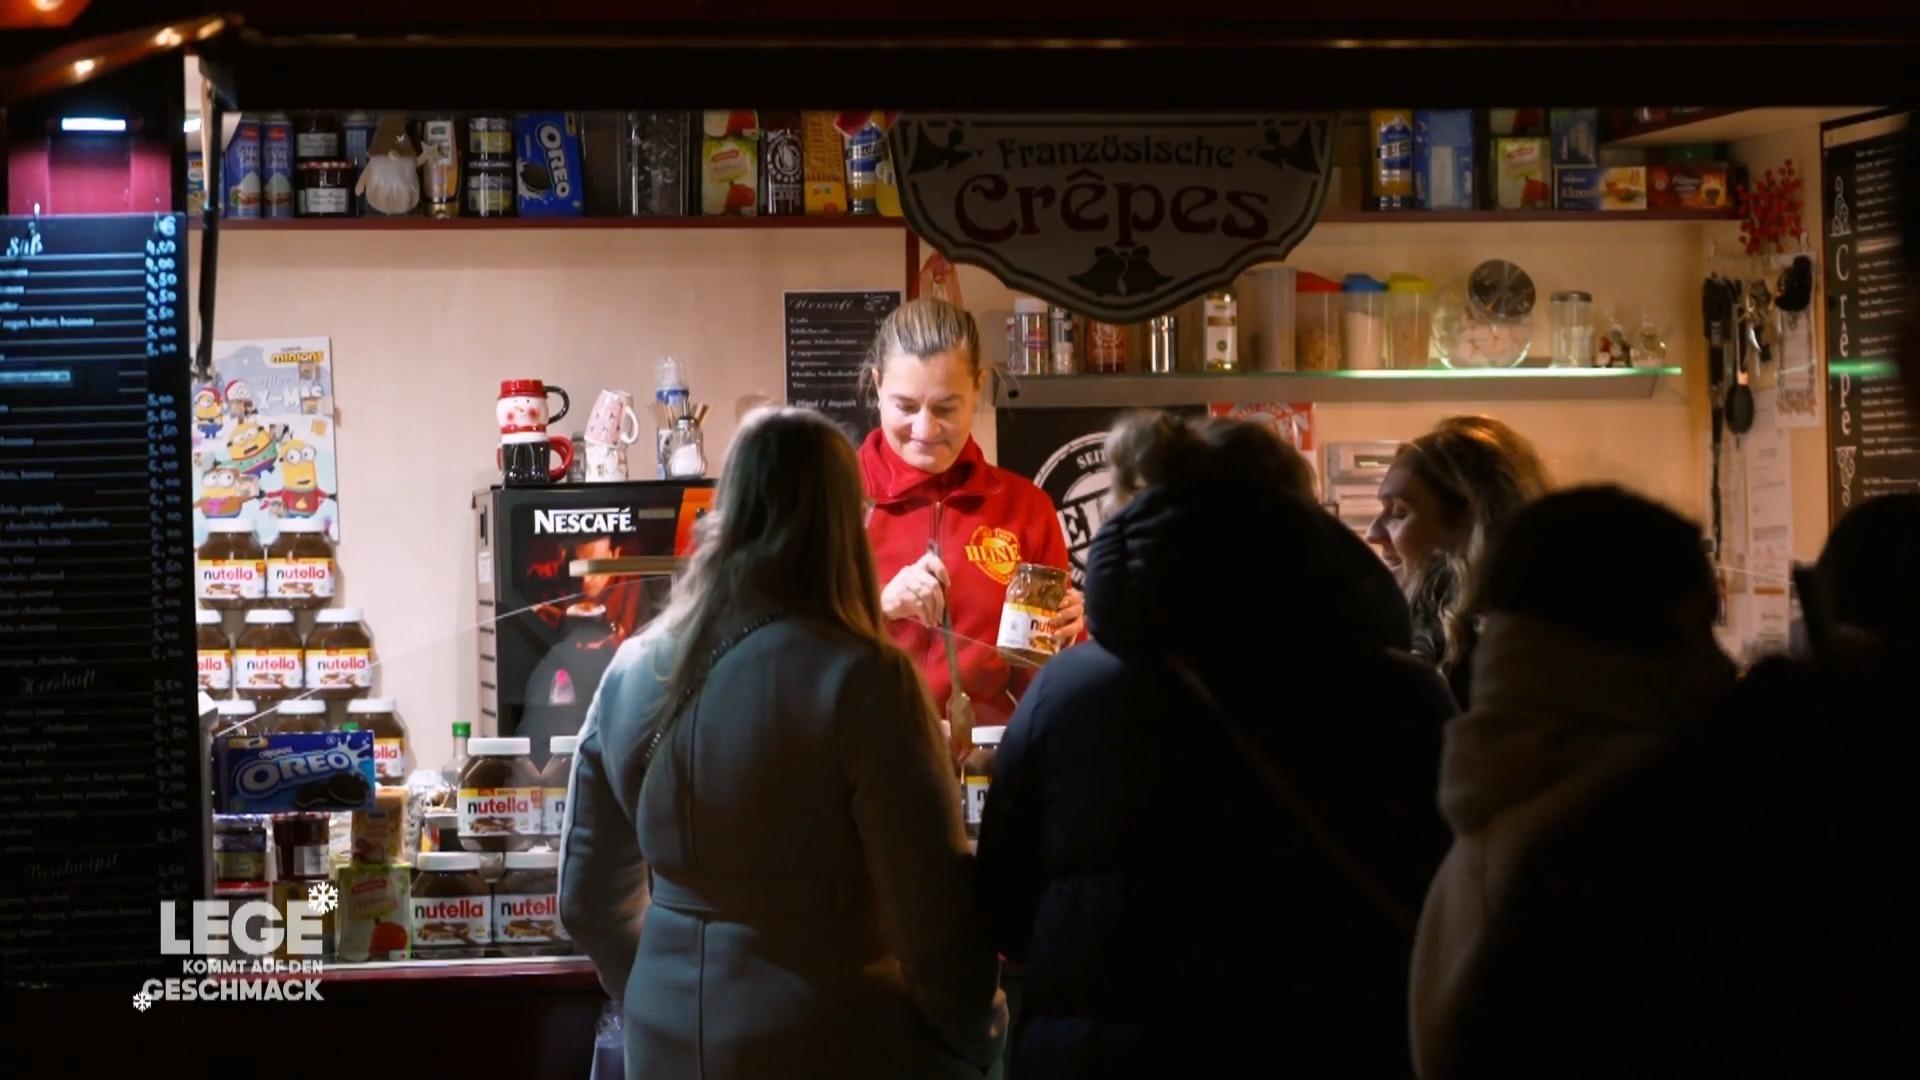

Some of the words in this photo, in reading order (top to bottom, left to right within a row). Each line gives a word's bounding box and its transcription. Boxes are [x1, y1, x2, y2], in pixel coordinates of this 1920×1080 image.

[998, 134, 1235, 168] Französische
[540, 125, 570, 197] OREO
[954, 168, 1271, 246] Crêpes
[271, 351, 323, 364] minions
[534, 506, 633, 534] NESCAFÉ
[204, 567, 253, 581] nutella
[276, 566, 325, 580] nutella
[196, 658, 222, 671] ella
[246, 657, 295, 670] nutella
[318, 656, 366, 670] nutella
[374, 747, 398, 759] ella
[242, 750, 347, 791] OREO
[467, 797, 528, 814] nutella
[414, 900, 484, 920] nutella
[500, 896, 557, 917] nutell
